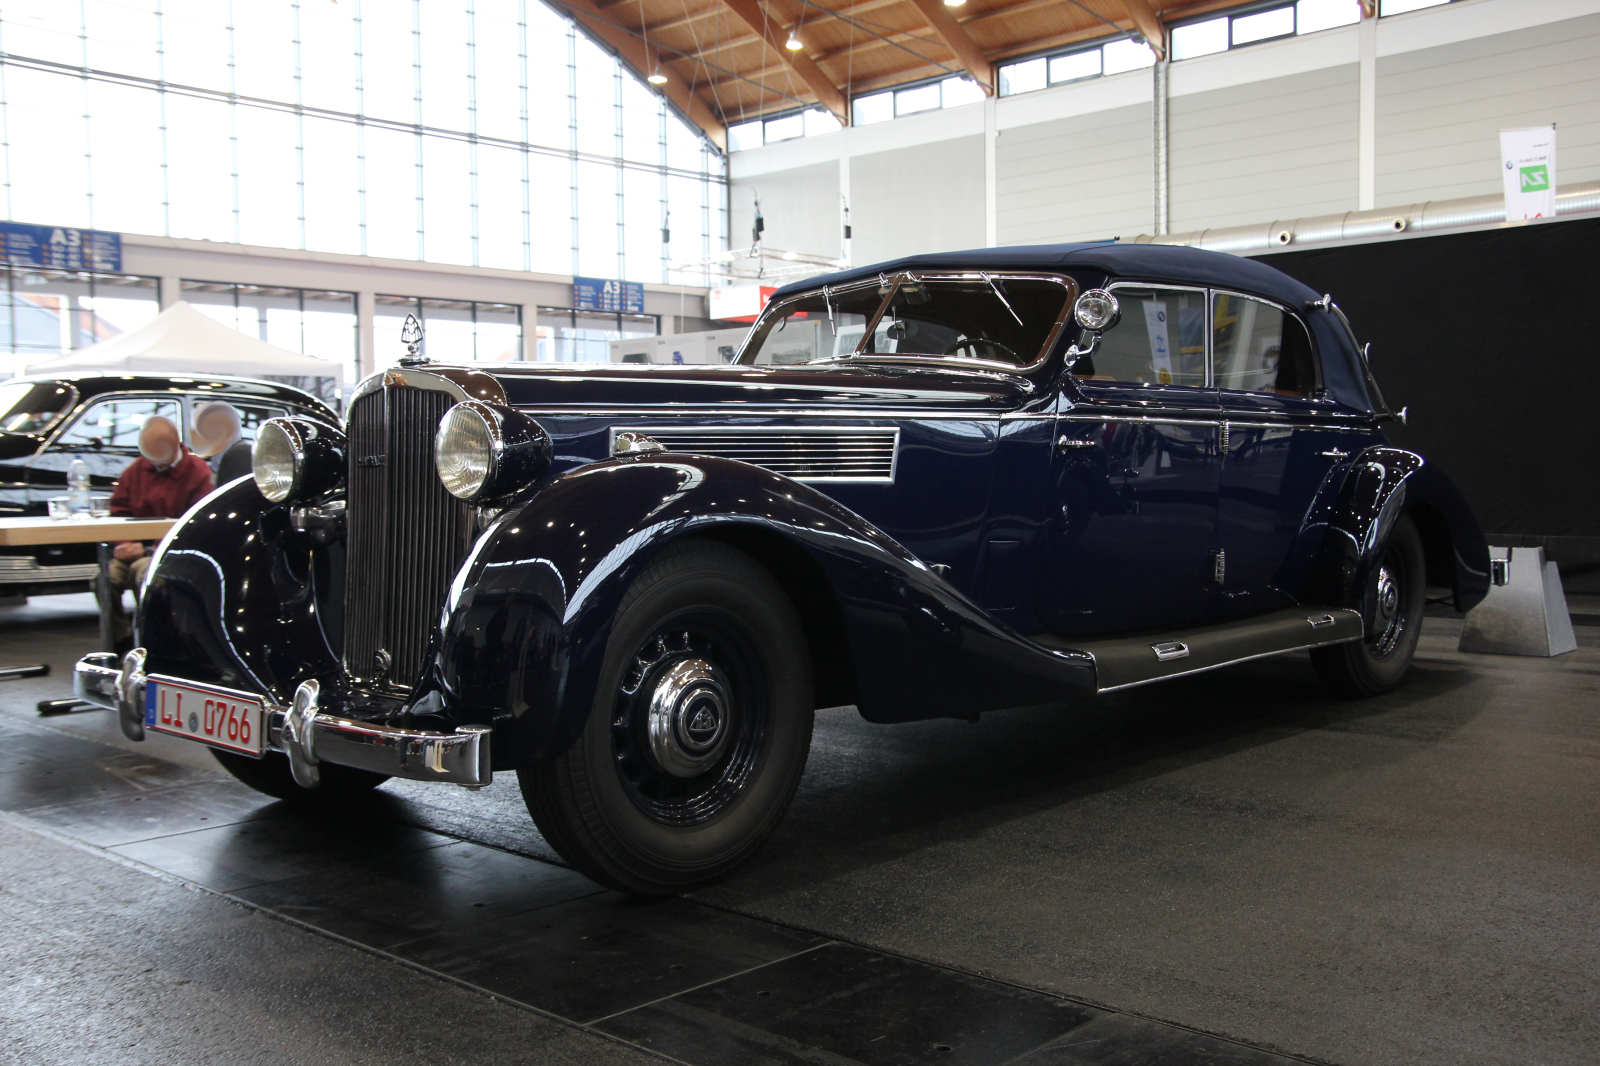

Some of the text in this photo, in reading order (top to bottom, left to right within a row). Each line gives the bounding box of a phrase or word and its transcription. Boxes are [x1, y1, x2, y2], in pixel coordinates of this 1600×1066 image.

[50, 228, 81, 247] A3
[603, 280, 621, 294] A3
[161, 688, 251, 744] LI 0766
